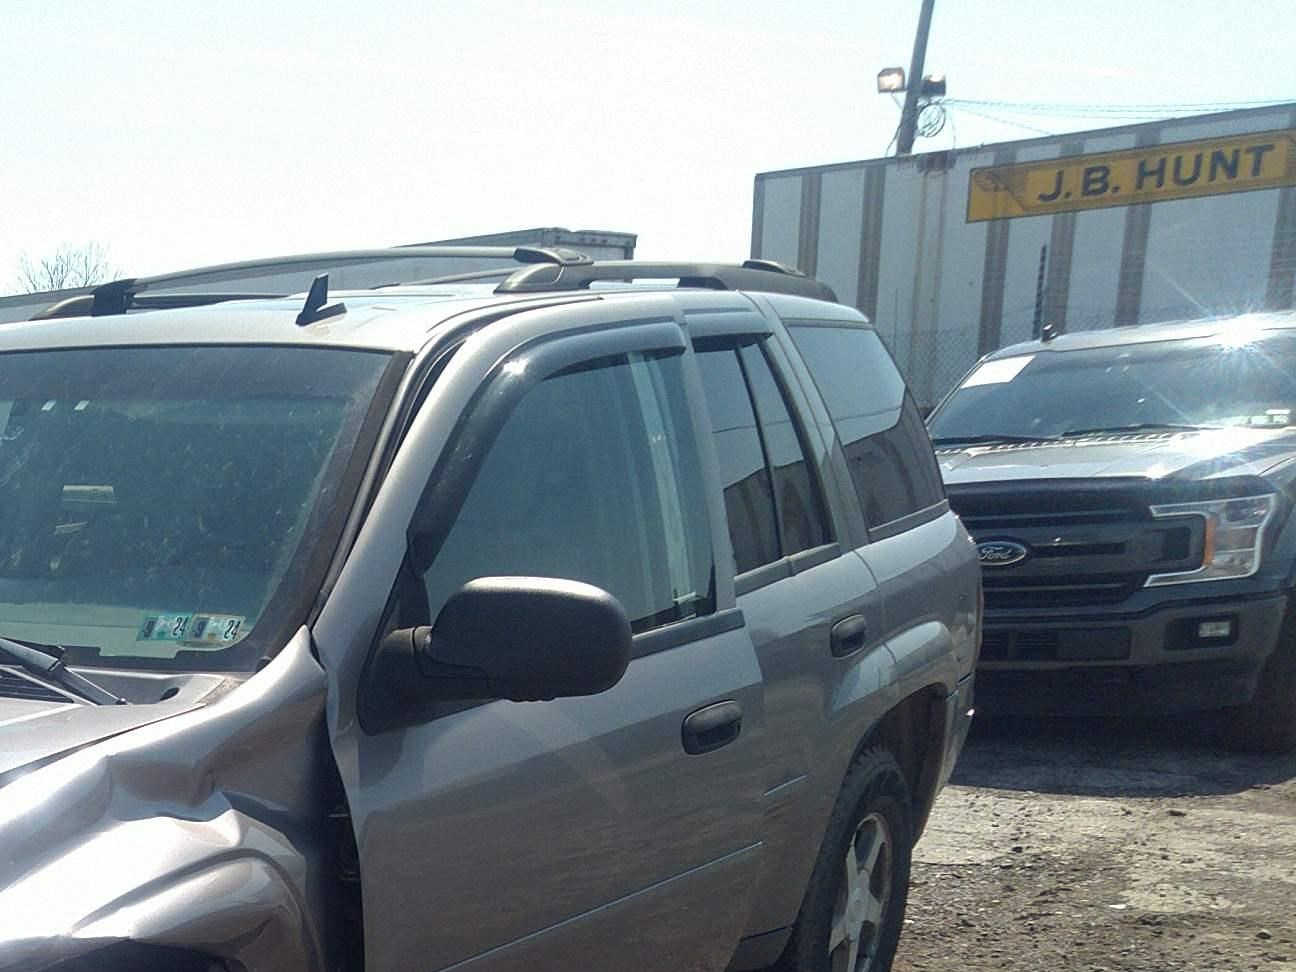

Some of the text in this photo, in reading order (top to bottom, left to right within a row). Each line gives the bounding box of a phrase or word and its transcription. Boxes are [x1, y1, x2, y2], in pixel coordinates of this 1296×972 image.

[1136, 144, 1275, 191] HUNT
[977, 546, 1012, 560] Ford
[172, 616, 189, 636] 24
[224, 619, 241, 640] 24
